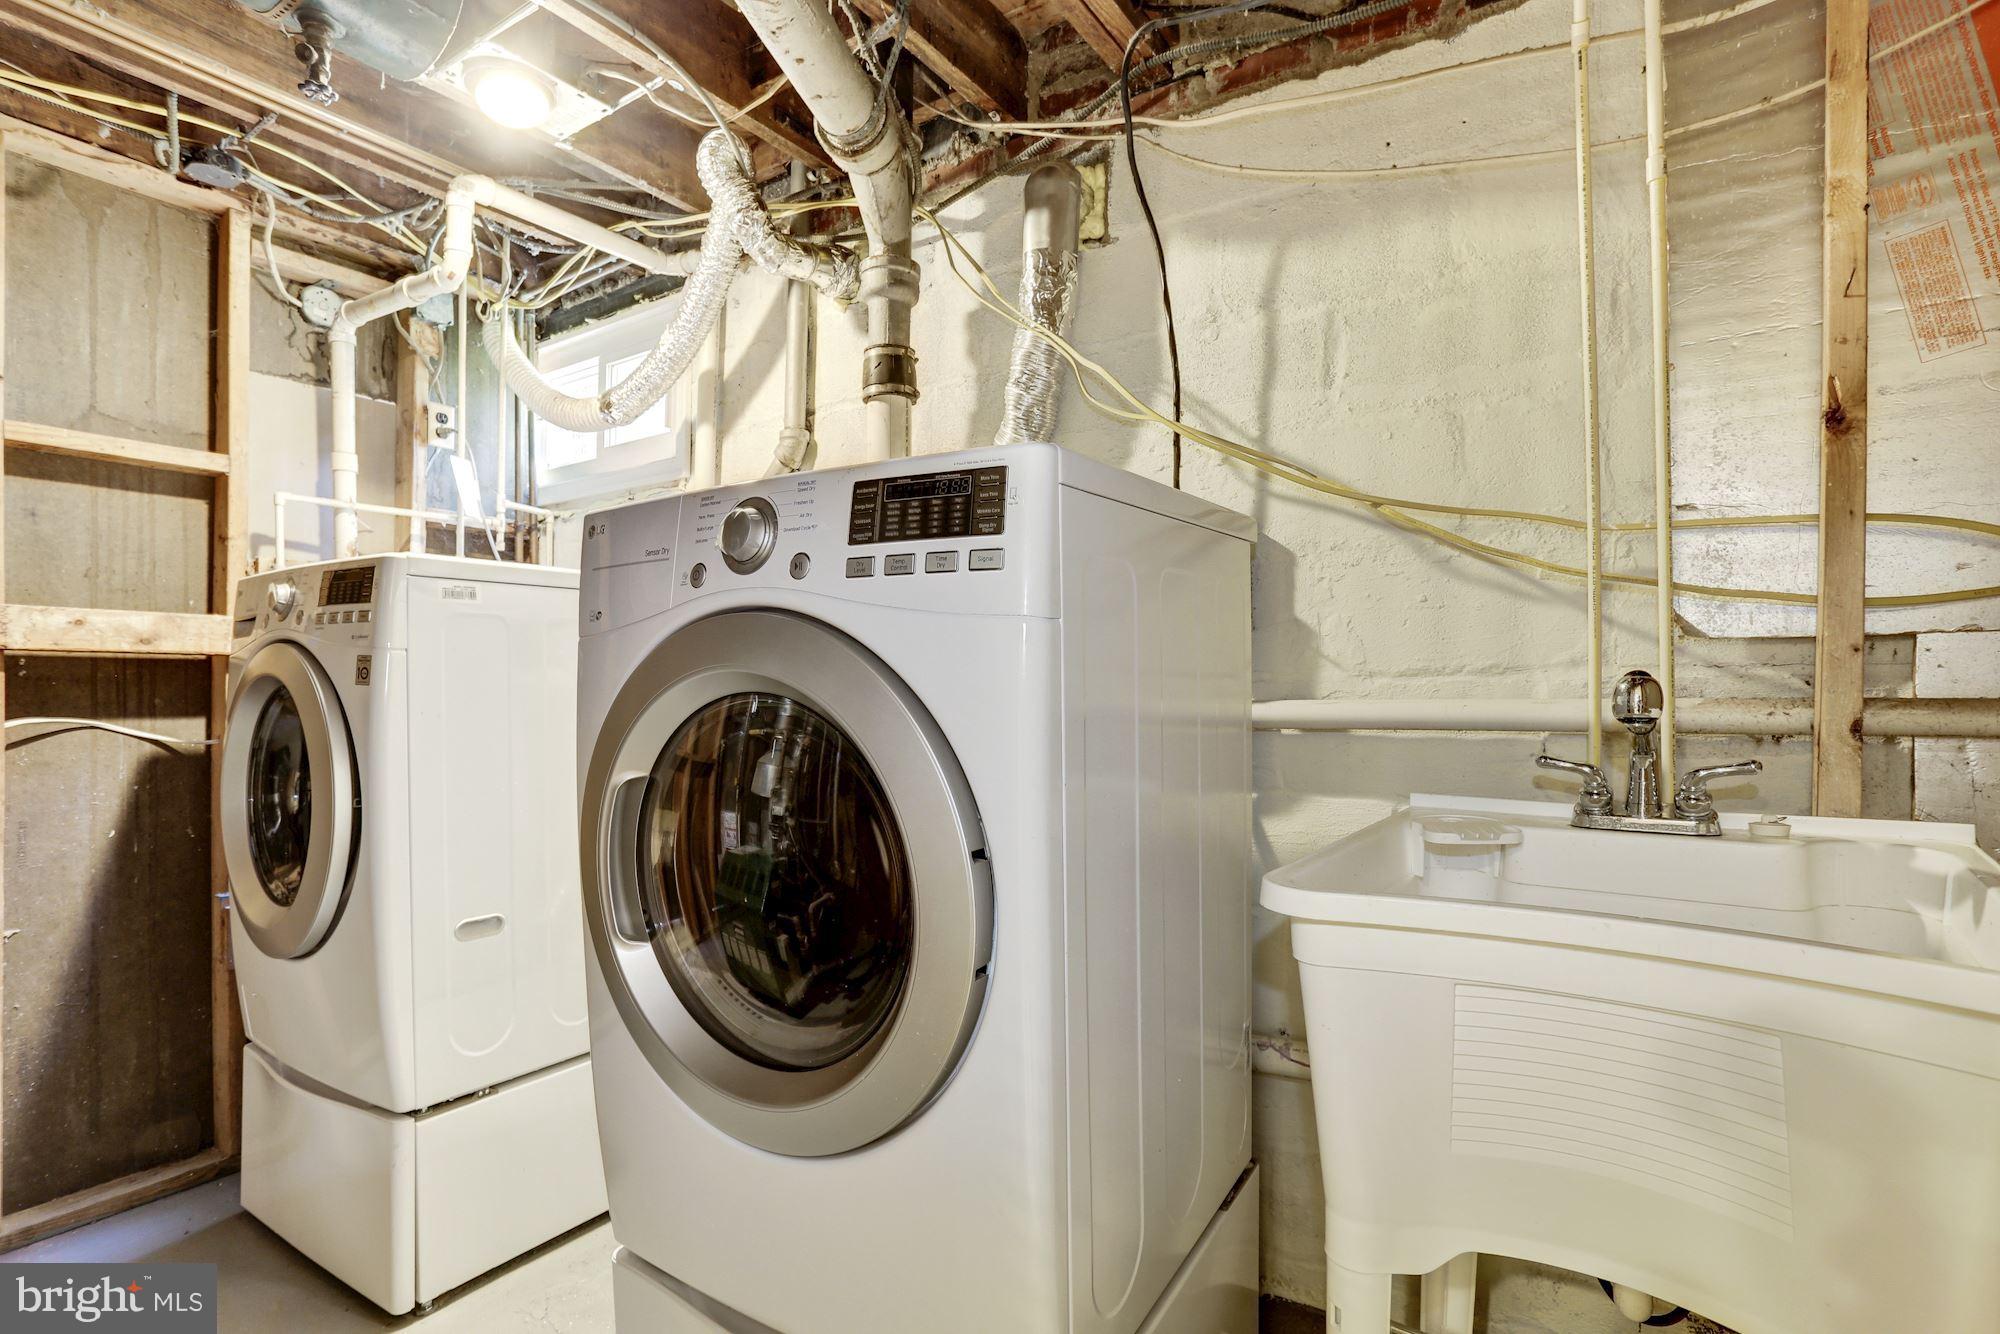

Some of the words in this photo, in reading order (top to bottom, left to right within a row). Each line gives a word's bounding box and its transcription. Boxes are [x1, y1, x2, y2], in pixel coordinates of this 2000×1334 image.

[1946, 156, 1959, 177] Actual
[1958, 152, 1972, 179] Nominal
[1968, 147, 1984, 174] Product
[1985, 198, 1993, 206] at
[1952, 177, 1968, 204] product
[1966, 178, 1982, 209] thickness
[1961, 204, 1978, 234] thickness
[1975, 209, 1992, 240] provided
[1972, 241, 1988, 265] slightly
[1986, 239, 1996, 250] for
[1981, 265, 1993, 279] less
[1988, 250, 2000, 273] design
[661, 547, 669, 555] Dry
